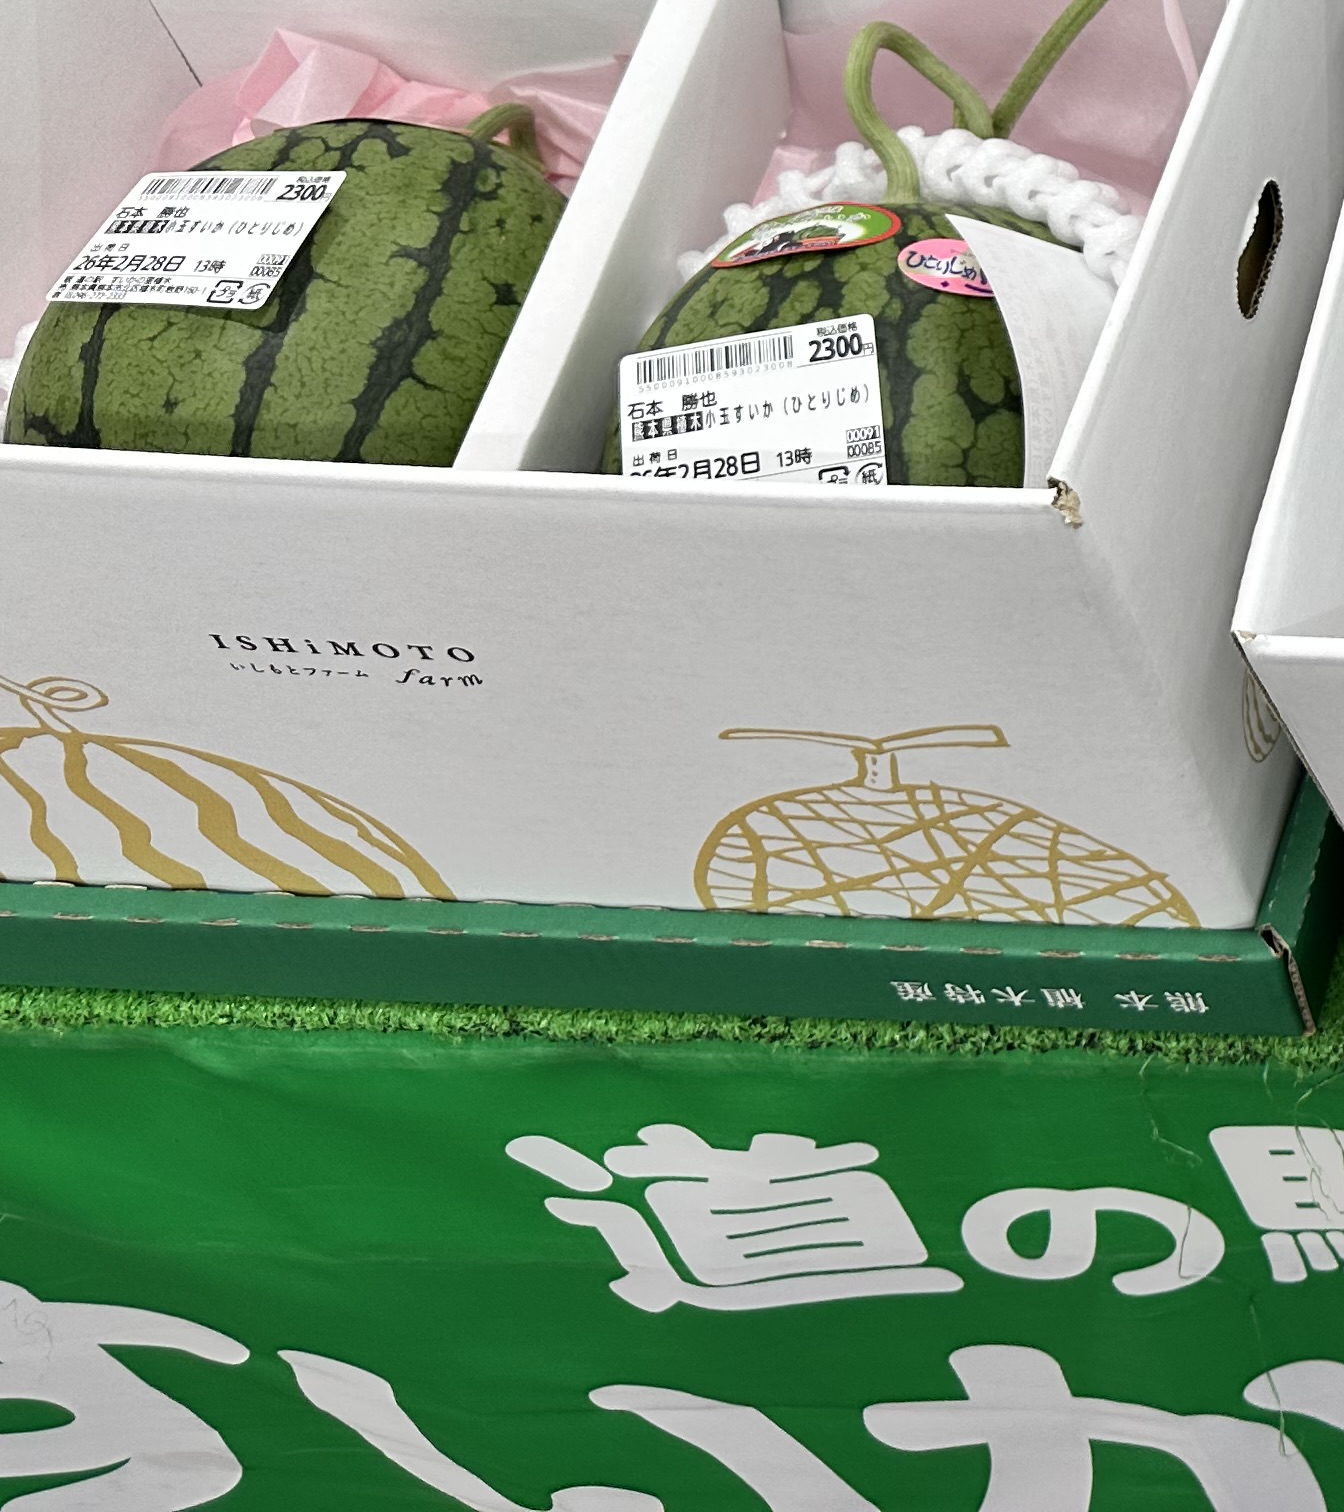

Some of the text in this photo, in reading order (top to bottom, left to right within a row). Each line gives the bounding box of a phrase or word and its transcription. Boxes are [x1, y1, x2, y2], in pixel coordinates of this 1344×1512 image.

[72, 254, 187, 273] 26年2月28日
[905, 249, 978, 282] ひとりじめ
[808, 335, 875, 364] 2300円
[627, 392, 718, 419] 石本 勝也
[633, 449, 678, 467] 出荷日
[776, 448, 813, 468] 13時
[846, 426, 881, 444] 00091
[847, 442, 882, 460] 00085
[395, 668, 483, 688] farm
[890, 980, 1210, 1014] 熊本 植木特産
